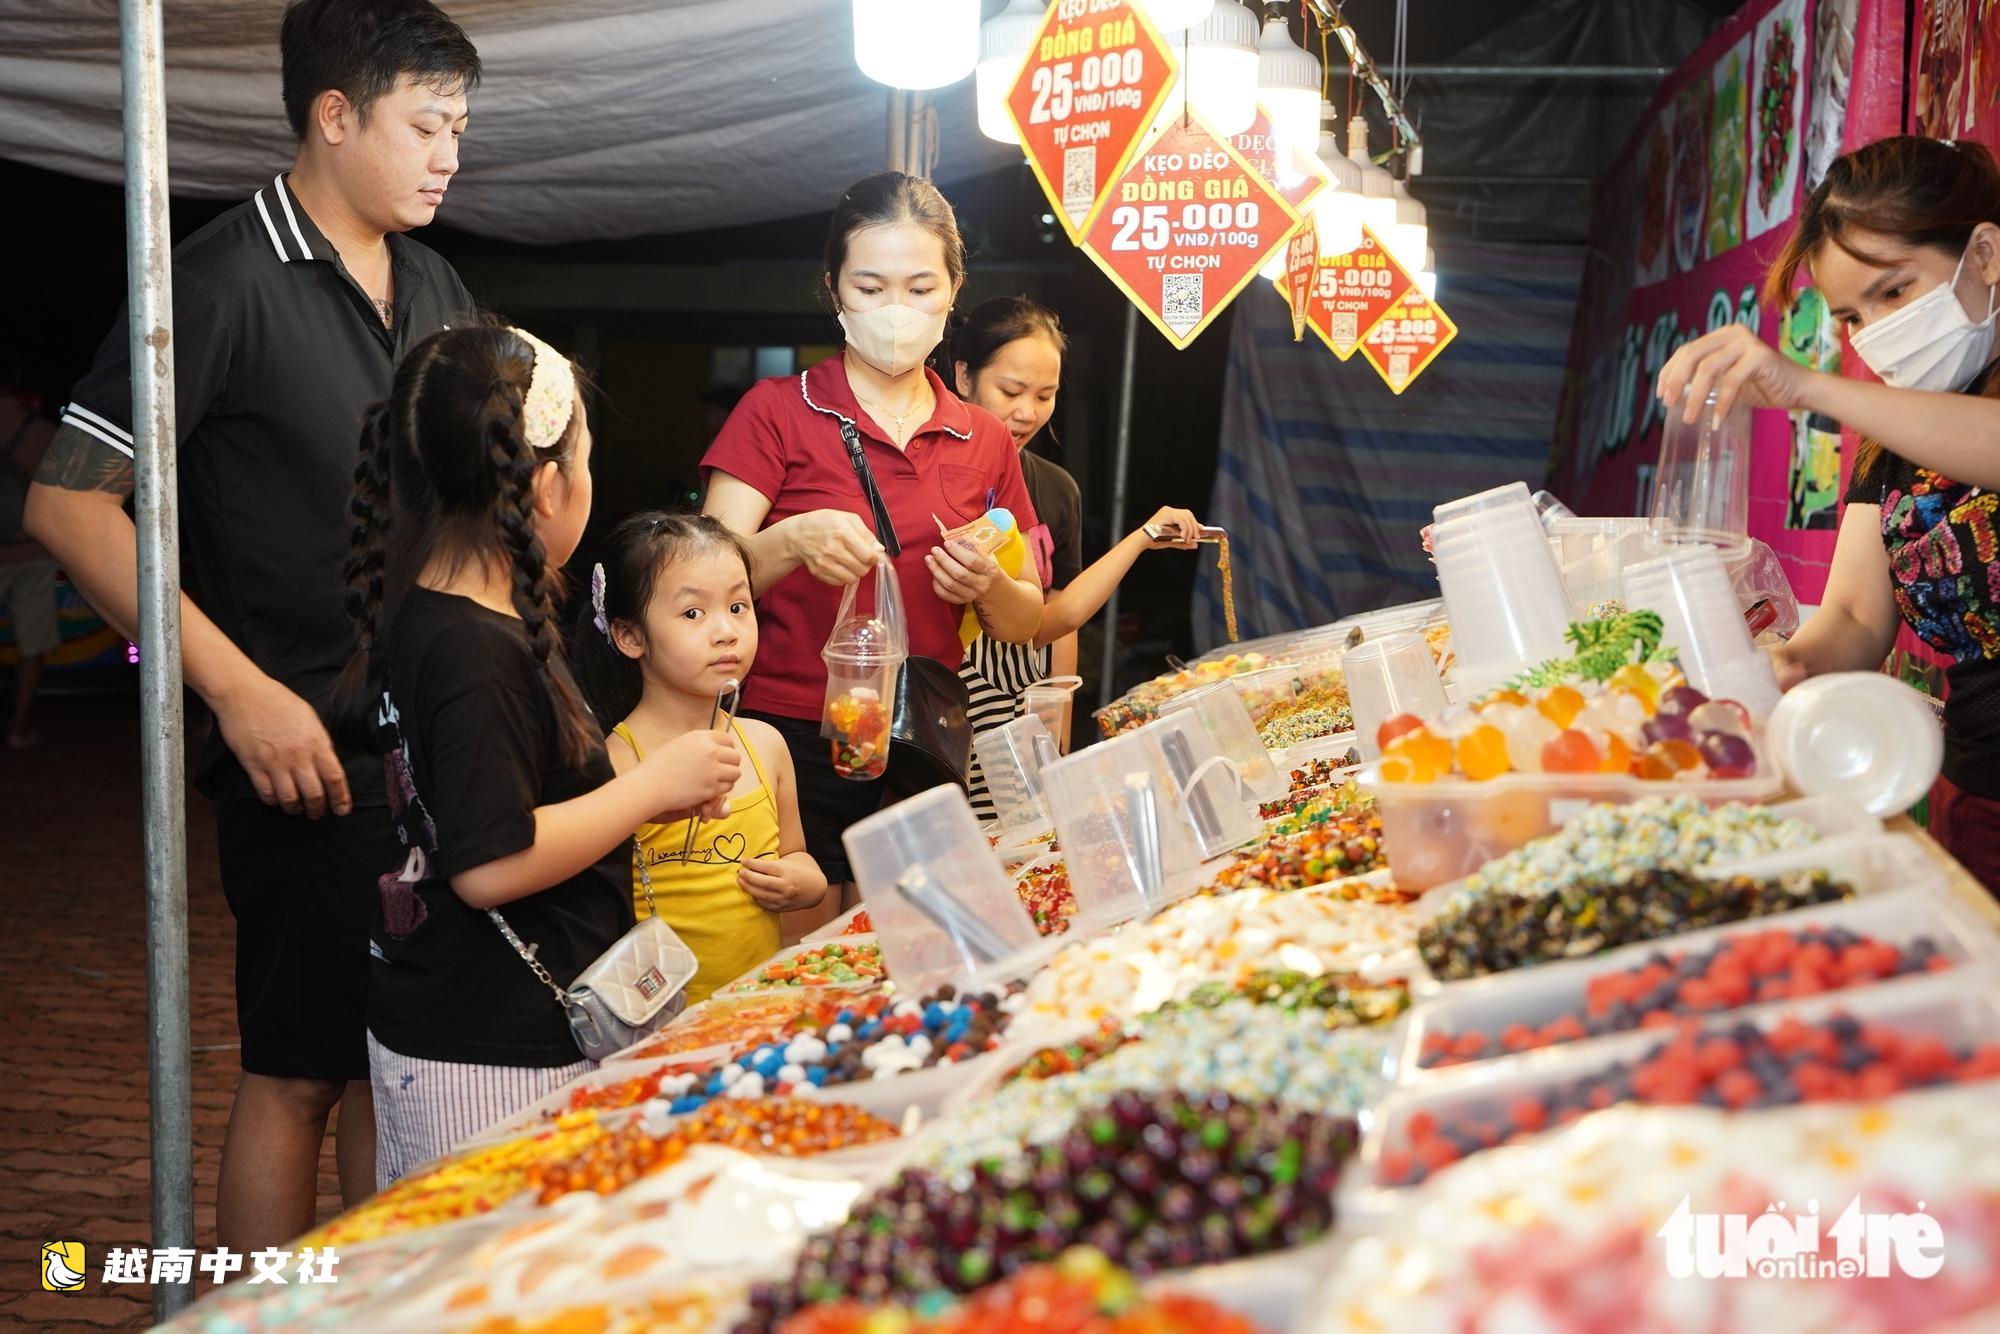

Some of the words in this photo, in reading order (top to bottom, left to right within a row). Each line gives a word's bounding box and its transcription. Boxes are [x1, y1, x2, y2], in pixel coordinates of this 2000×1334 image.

[1040, 23, 1093, 62] ĐỒNG
[1099, 12, 1136, 50] GIÁ
[1029, 48, 1143, 124] 25.000
[1053, 124, 1070, 149] TỰ
[1070, 119, 1110, 144] CHỌN
[1144, 154, 1183, 176] KẸO
[1189, 147, 1229, 171] DẺO
[1121, 175, 1195, 202] ĐỒNG
[1204, 175, 1249, 199] GIÁ
[1111, 202, 1259, 251] 25.000
[1174, 232, 1259, 248] VNĐ/100g
[1147, 255, 1167, 272] TỰ
[1170, 255, 1221, 272] CHỌN
[1358, 252, 1387, 268] GIÁ
